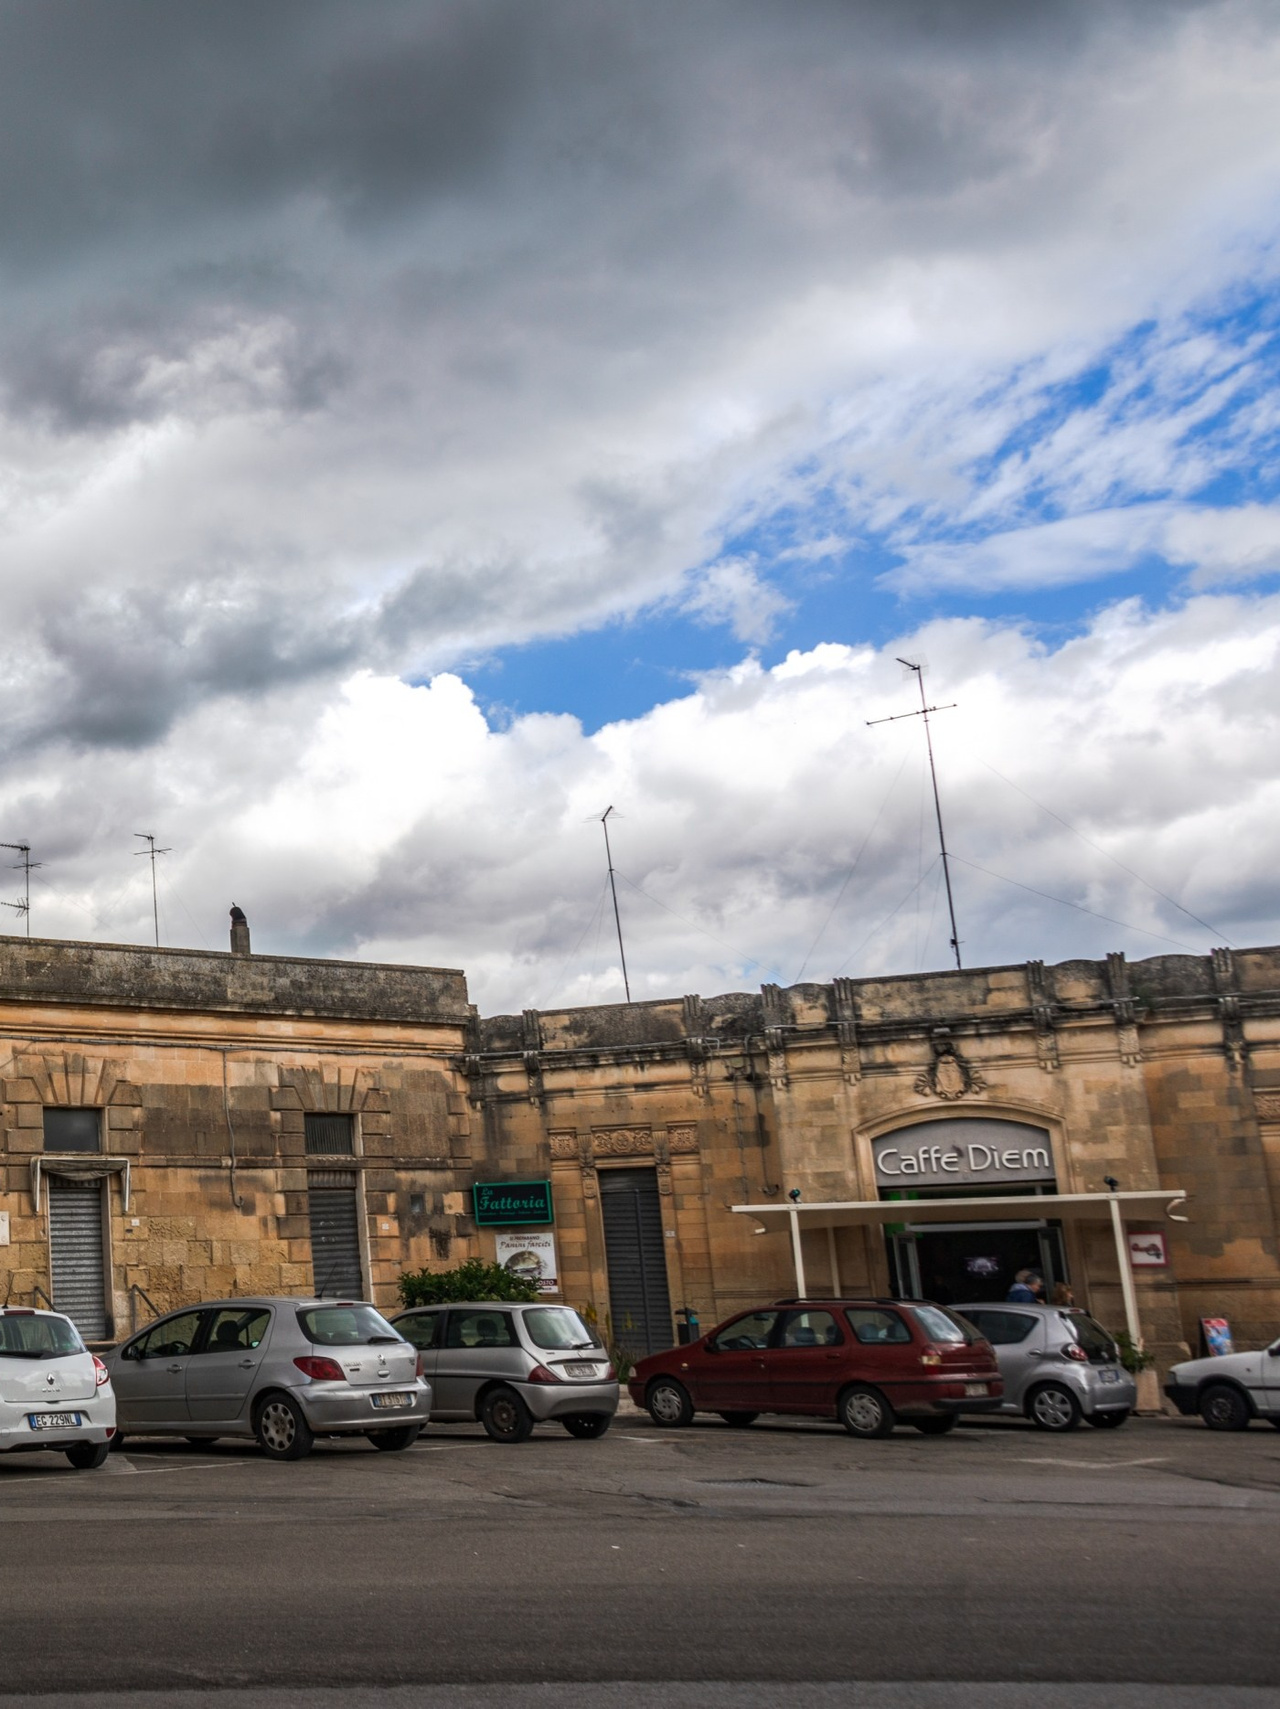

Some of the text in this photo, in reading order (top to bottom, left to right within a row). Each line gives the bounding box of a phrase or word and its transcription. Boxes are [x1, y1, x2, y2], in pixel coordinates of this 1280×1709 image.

[968, 1144, 1050, 1171] Diem
[481, 1187, 494, 1196] La
[479, 1195, 546, 1210] Fattoria
[499, 1241, 526, 1249] Panini
